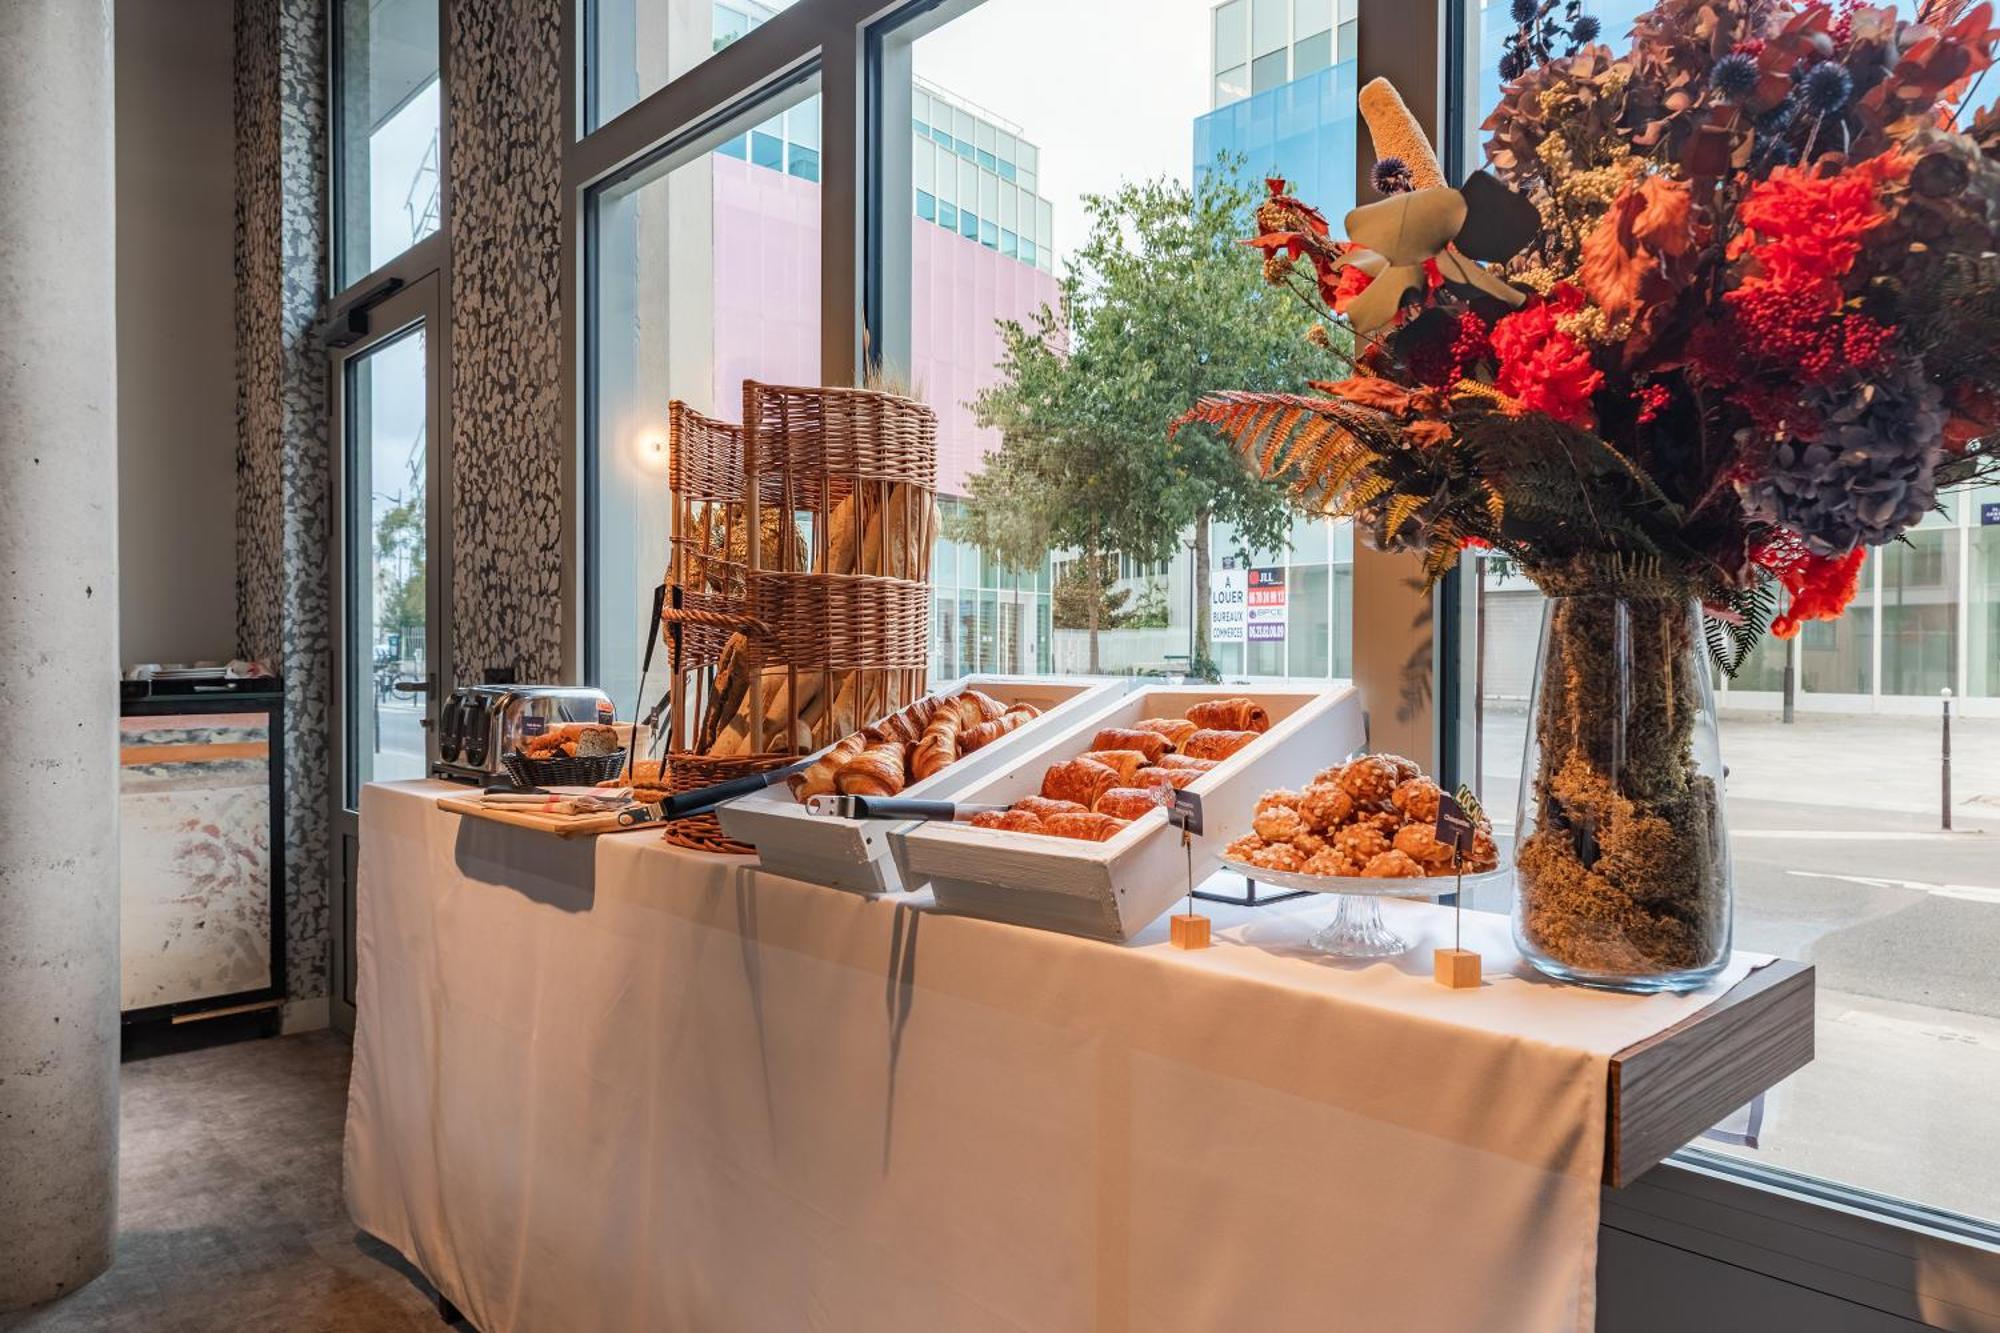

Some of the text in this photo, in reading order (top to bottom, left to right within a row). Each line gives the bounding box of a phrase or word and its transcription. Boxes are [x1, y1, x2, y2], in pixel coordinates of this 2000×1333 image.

[1260, 572, 1274, 582] JLL
[1213, 591, 1243, 604] LOUER
[1213, 611, 1243, 622] BUREAUX
[1213, 627, 1243, 638] COMMERCES
